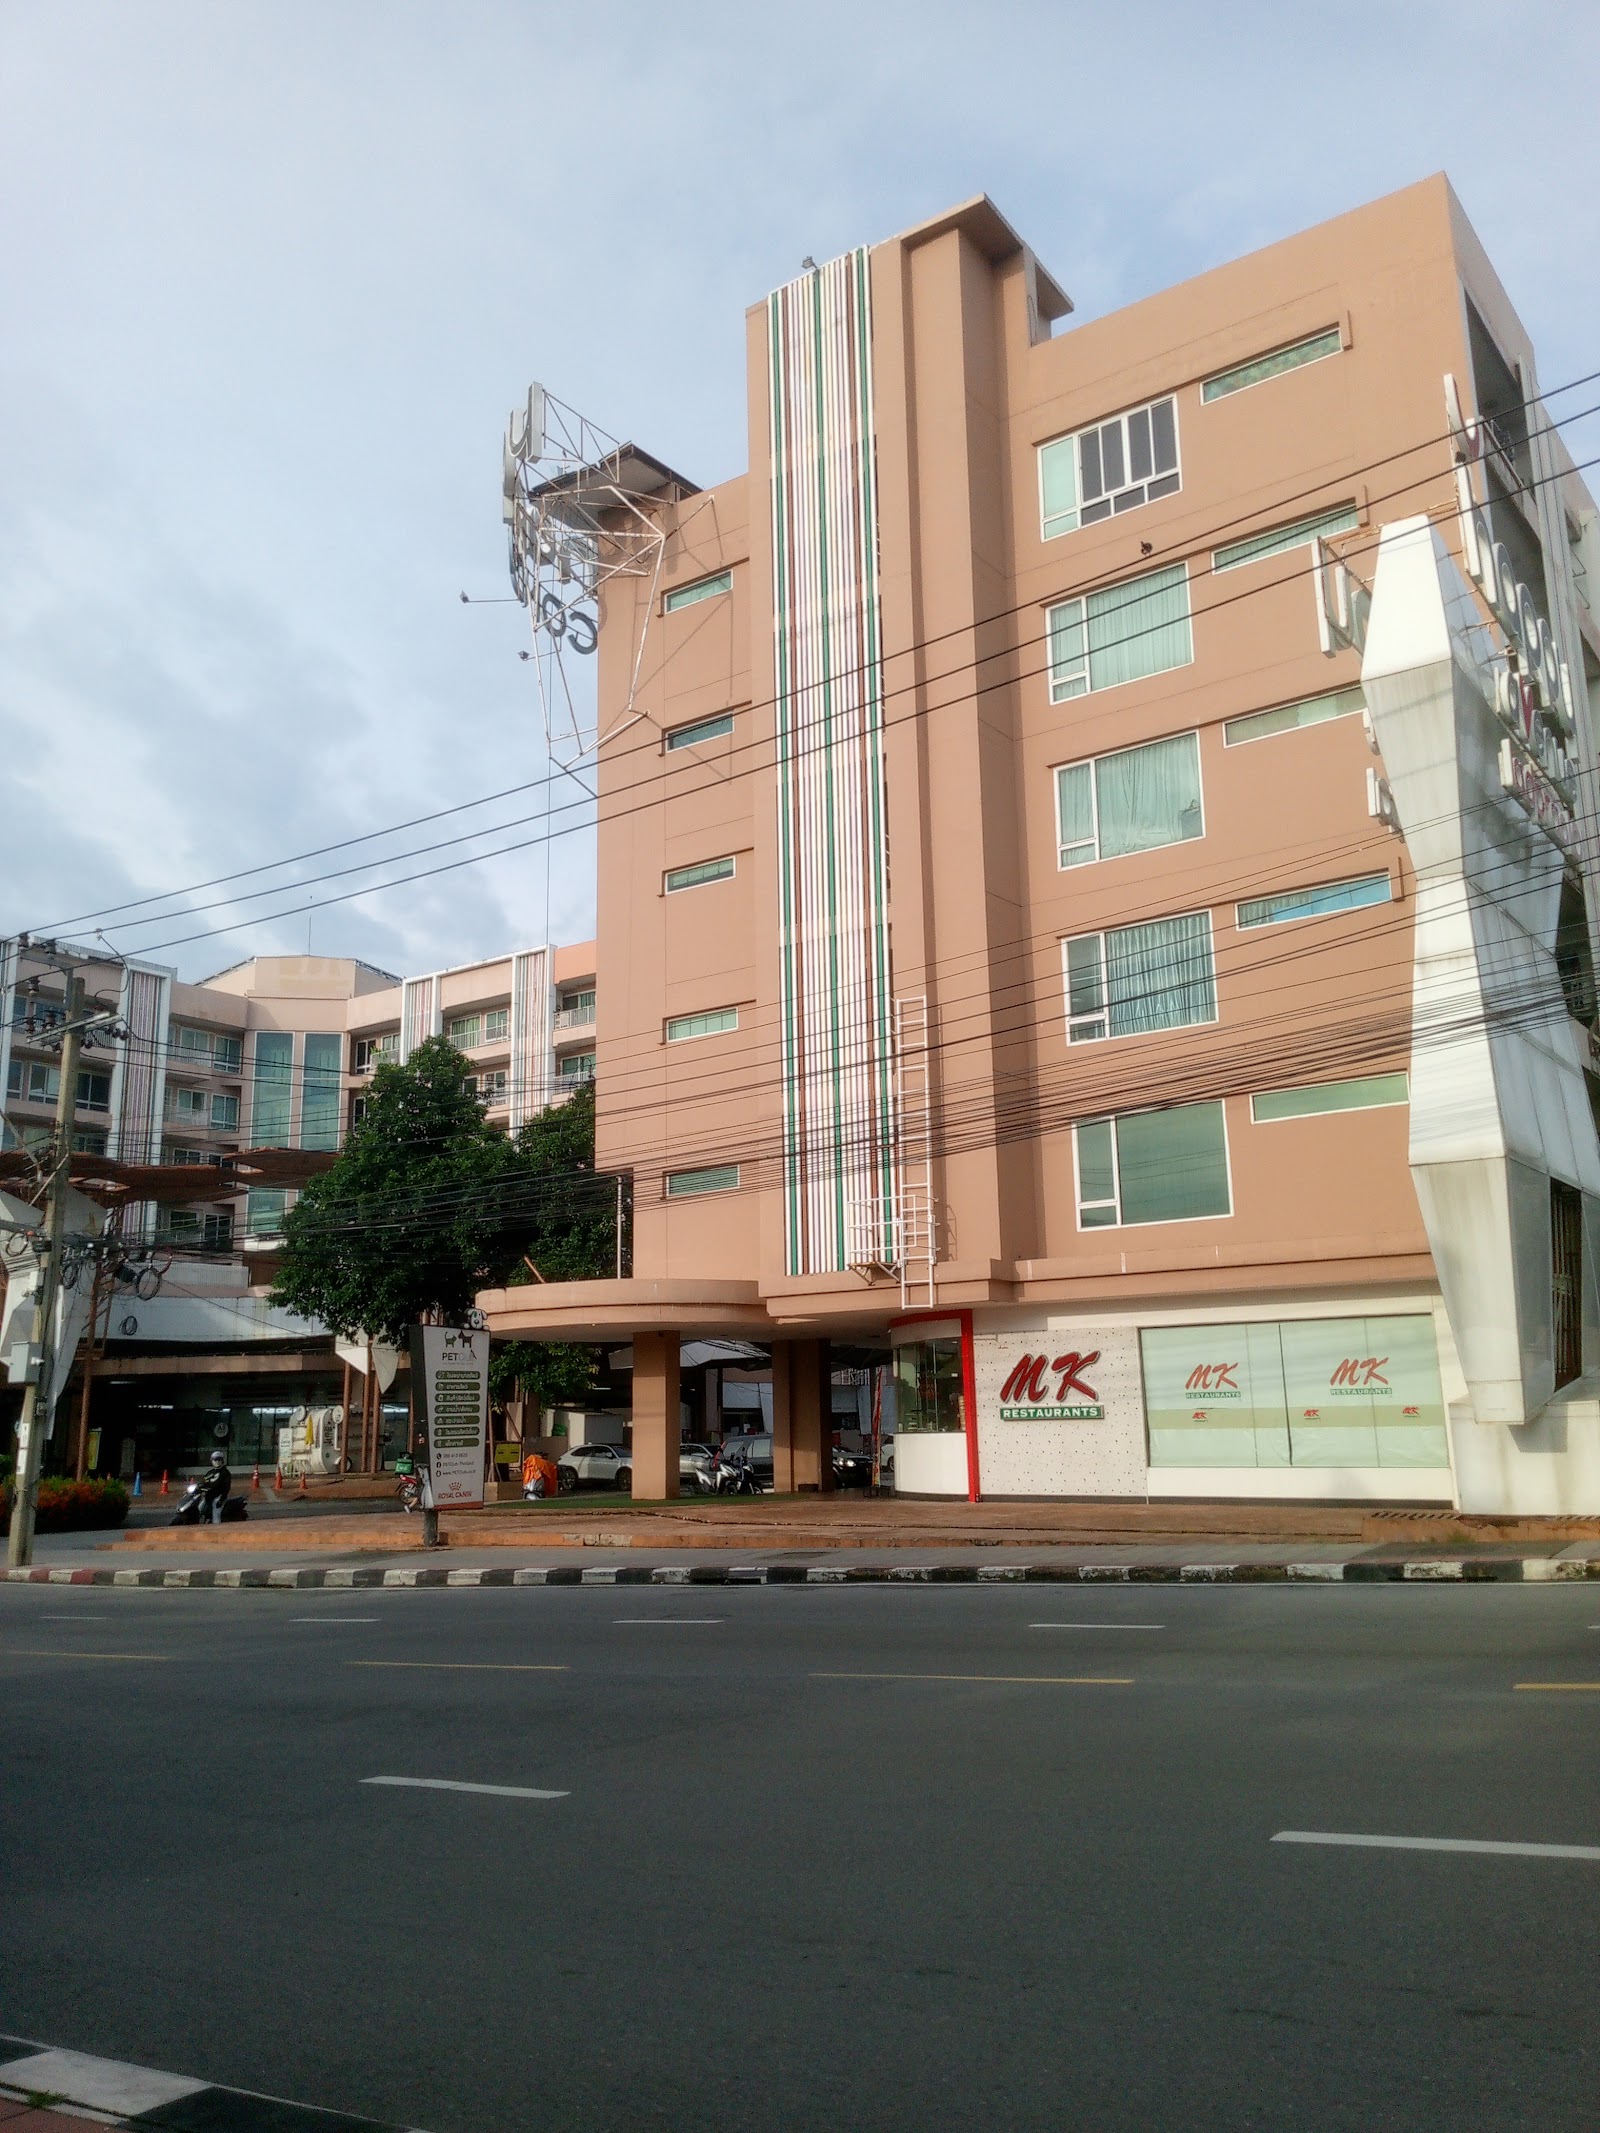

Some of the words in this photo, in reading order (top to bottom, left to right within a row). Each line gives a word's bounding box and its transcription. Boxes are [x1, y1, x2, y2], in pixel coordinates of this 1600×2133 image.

[1000, 1350, 1101, 1403] MK
[1185, 1362, 1239, 1390] MK
[1330, 1357, 1389, 1386] MK
[1003, 1407, 1098, 1418] RESTAURANTS
